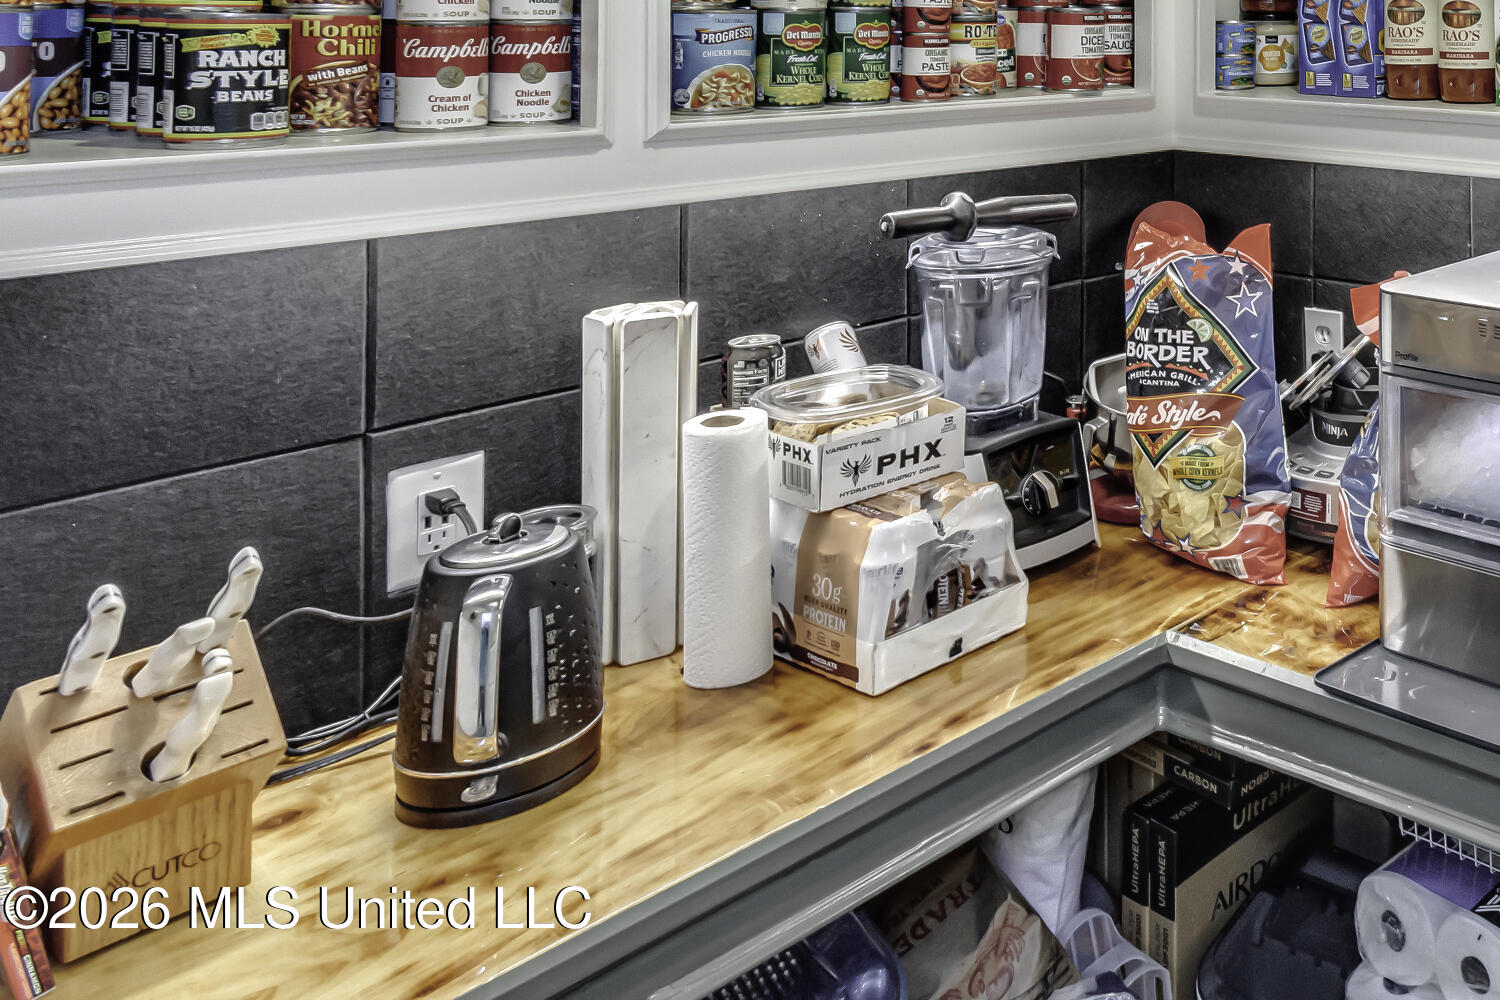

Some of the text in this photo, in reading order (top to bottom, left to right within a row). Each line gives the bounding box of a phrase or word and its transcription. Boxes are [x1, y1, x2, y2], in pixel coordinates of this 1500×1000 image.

[443, 10, 470, 18] SOUP
[532, 9, 557, 17] SOUP
[302, 20, 380, 39] Hormel
[701, 27, 753, 43] PROGRESSO
[1388, 26, 1424, 39] RAO'S
[1442, 30, 1481, 43] RAO'S
[317, 38, 376, 57] Chili
[702, 49, 730, 57] CHICKEN
[1104, 41, 1133, 51] SAUCE
[198, 50, 286, 67] RANCH
[306, 63, 368, 83] with Beans
[791, 66, 816, 75] WHOLE
[922, 63, 949, 73] PASTE
[187, 70, 290, 90] STYLE
[776, 74, 807, 84] KERNEL
[214, 90, 273, 103] BEANS
[428, 94, 471, 105] Cream of
[515, 89, 551, 99] Chicken
[431, 106, 470, 115] Chicken
[516, 99, 550, 109] Noodle
[437, 117, 464, 126] SOUP
[519, 111, 546, 120] SOUP
[1134, 326, 1195, 345] ON THE
[1126, 340, 1214, 373] BORDER
[1395, 350, 1420, 362] Profile
[1170, 371, 1197, 386] GRILL
[1151, 399, 1222, 431] Style
[1322, 421, 1348, 437] NINJA
[825, 435, 882, 455] VARIETY PACK
[783, 442, 814, 465] PHX
[876, 438, 945, 476] PHX
[839, 463, 941, 498] HYDRATION ENERGY DRINK
[811, 573, 844, 604] 30g
[803, 604, 847, 633] PROTEIN
[1173, 764, 1219, 794] CARBON
[131, 839, 223, 889] CUTCO
[1131, 827, 1140, 894] UltraHEPA
[1157, 840, 1167, 908] UltraHEPA
